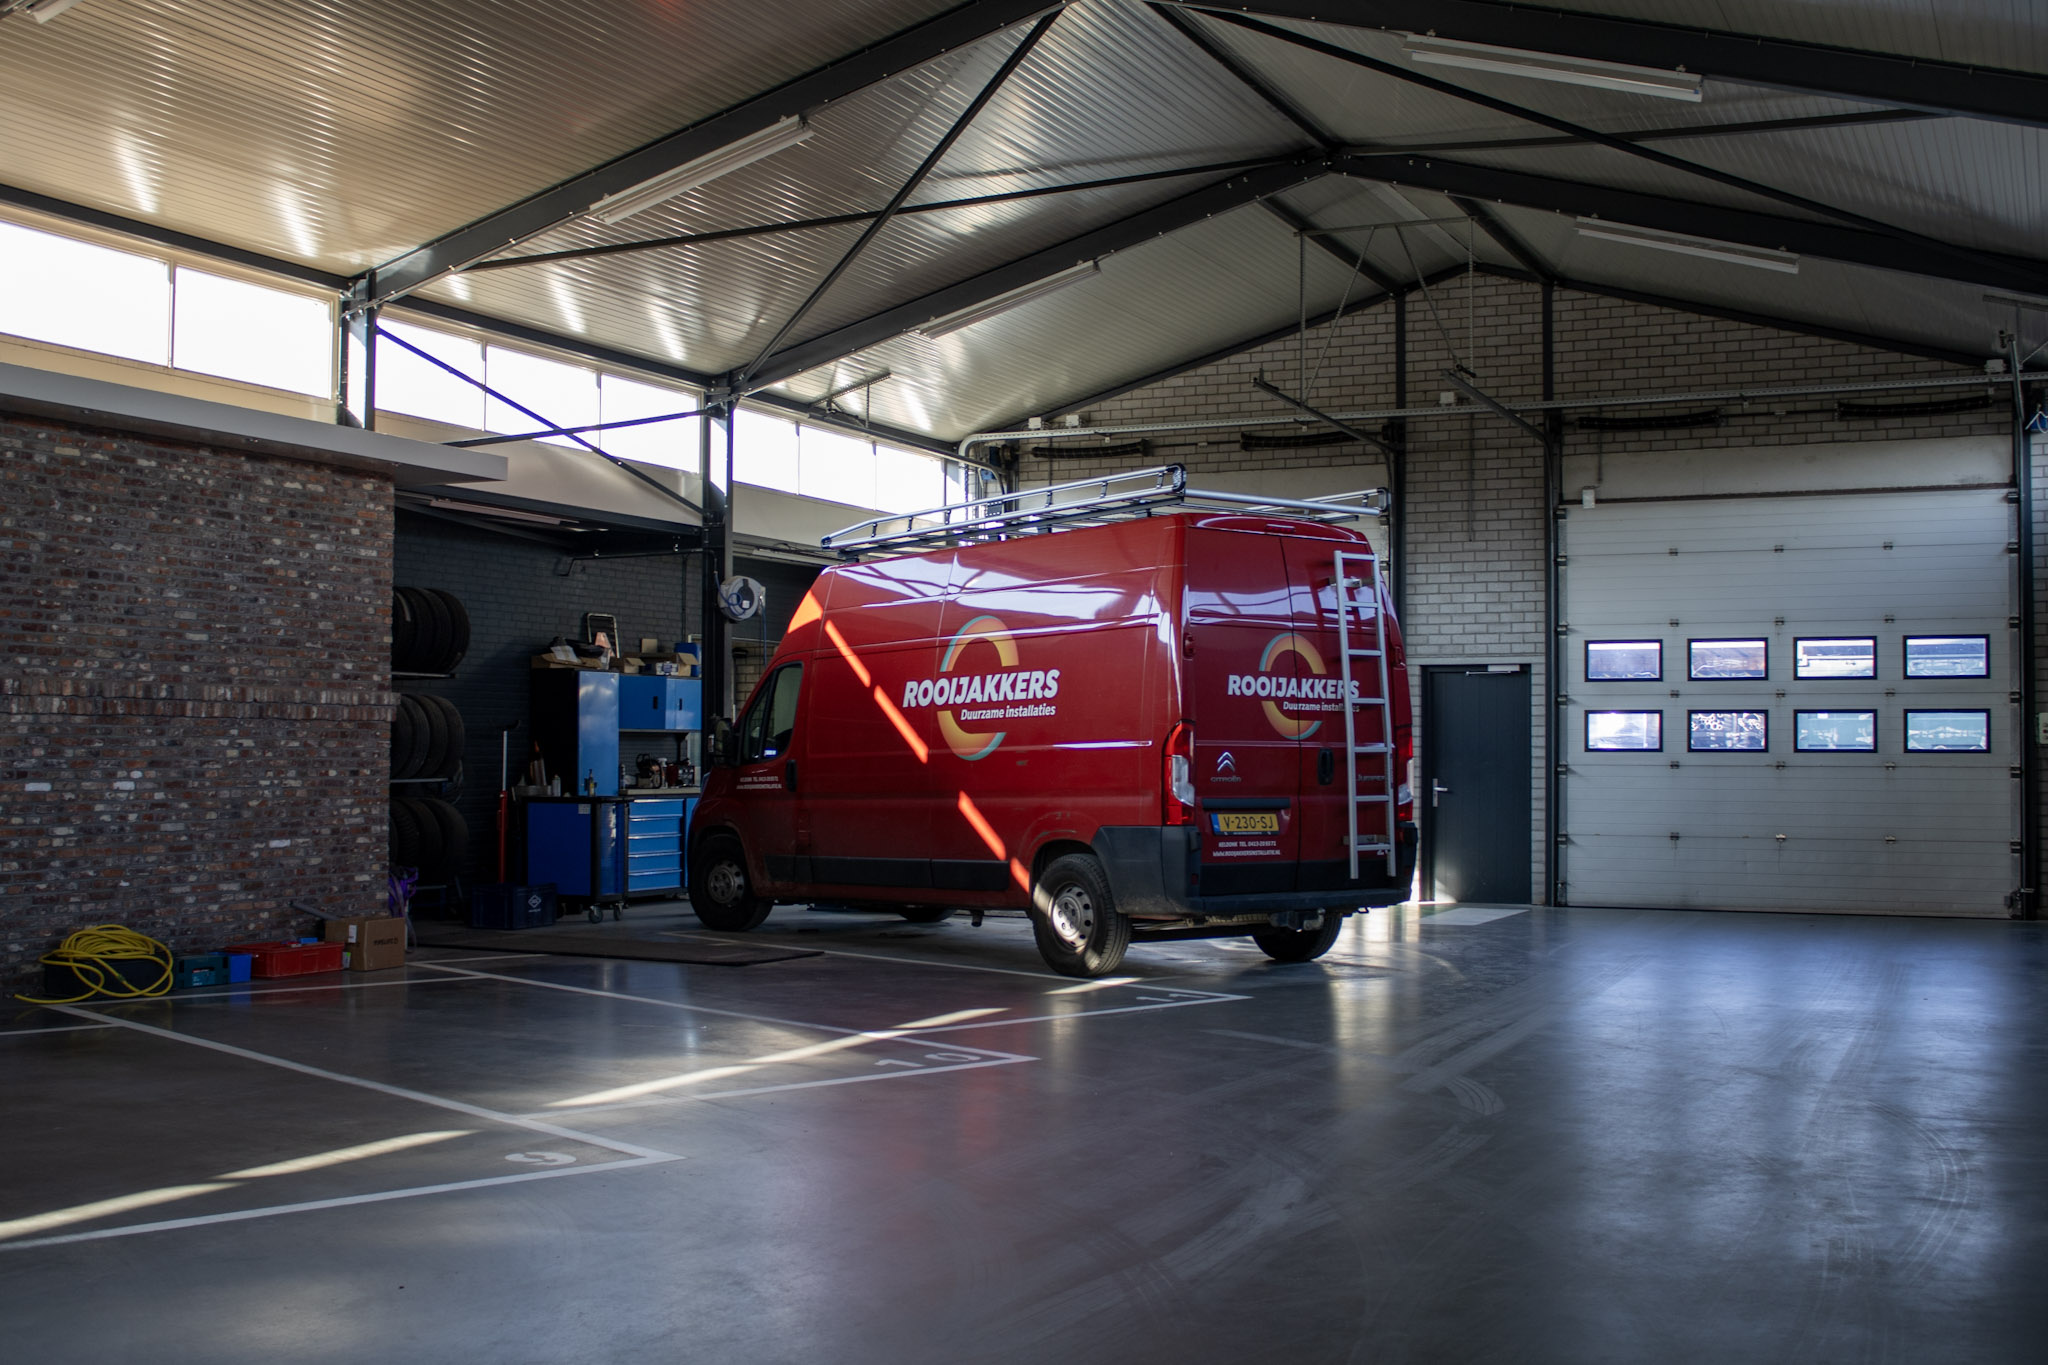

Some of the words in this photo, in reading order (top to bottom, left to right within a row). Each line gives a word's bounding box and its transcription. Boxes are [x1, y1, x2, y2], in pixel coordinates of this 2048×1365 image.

[902, 669, 1060, 708] ROOIJAKKERS
[1227, 674, 1360, 700] ROOIJAKKERS
[960, 706, 1004, 721] Duurzame
[1005, 703, 1056, 718] installaties
[1283, 701, 1320, 711] Duurzame
[1321, 702, 1360, 712] installes
[1223, 816, 1274, 829] V-230-SJ
[874, 1052, 981, 1068] 10
